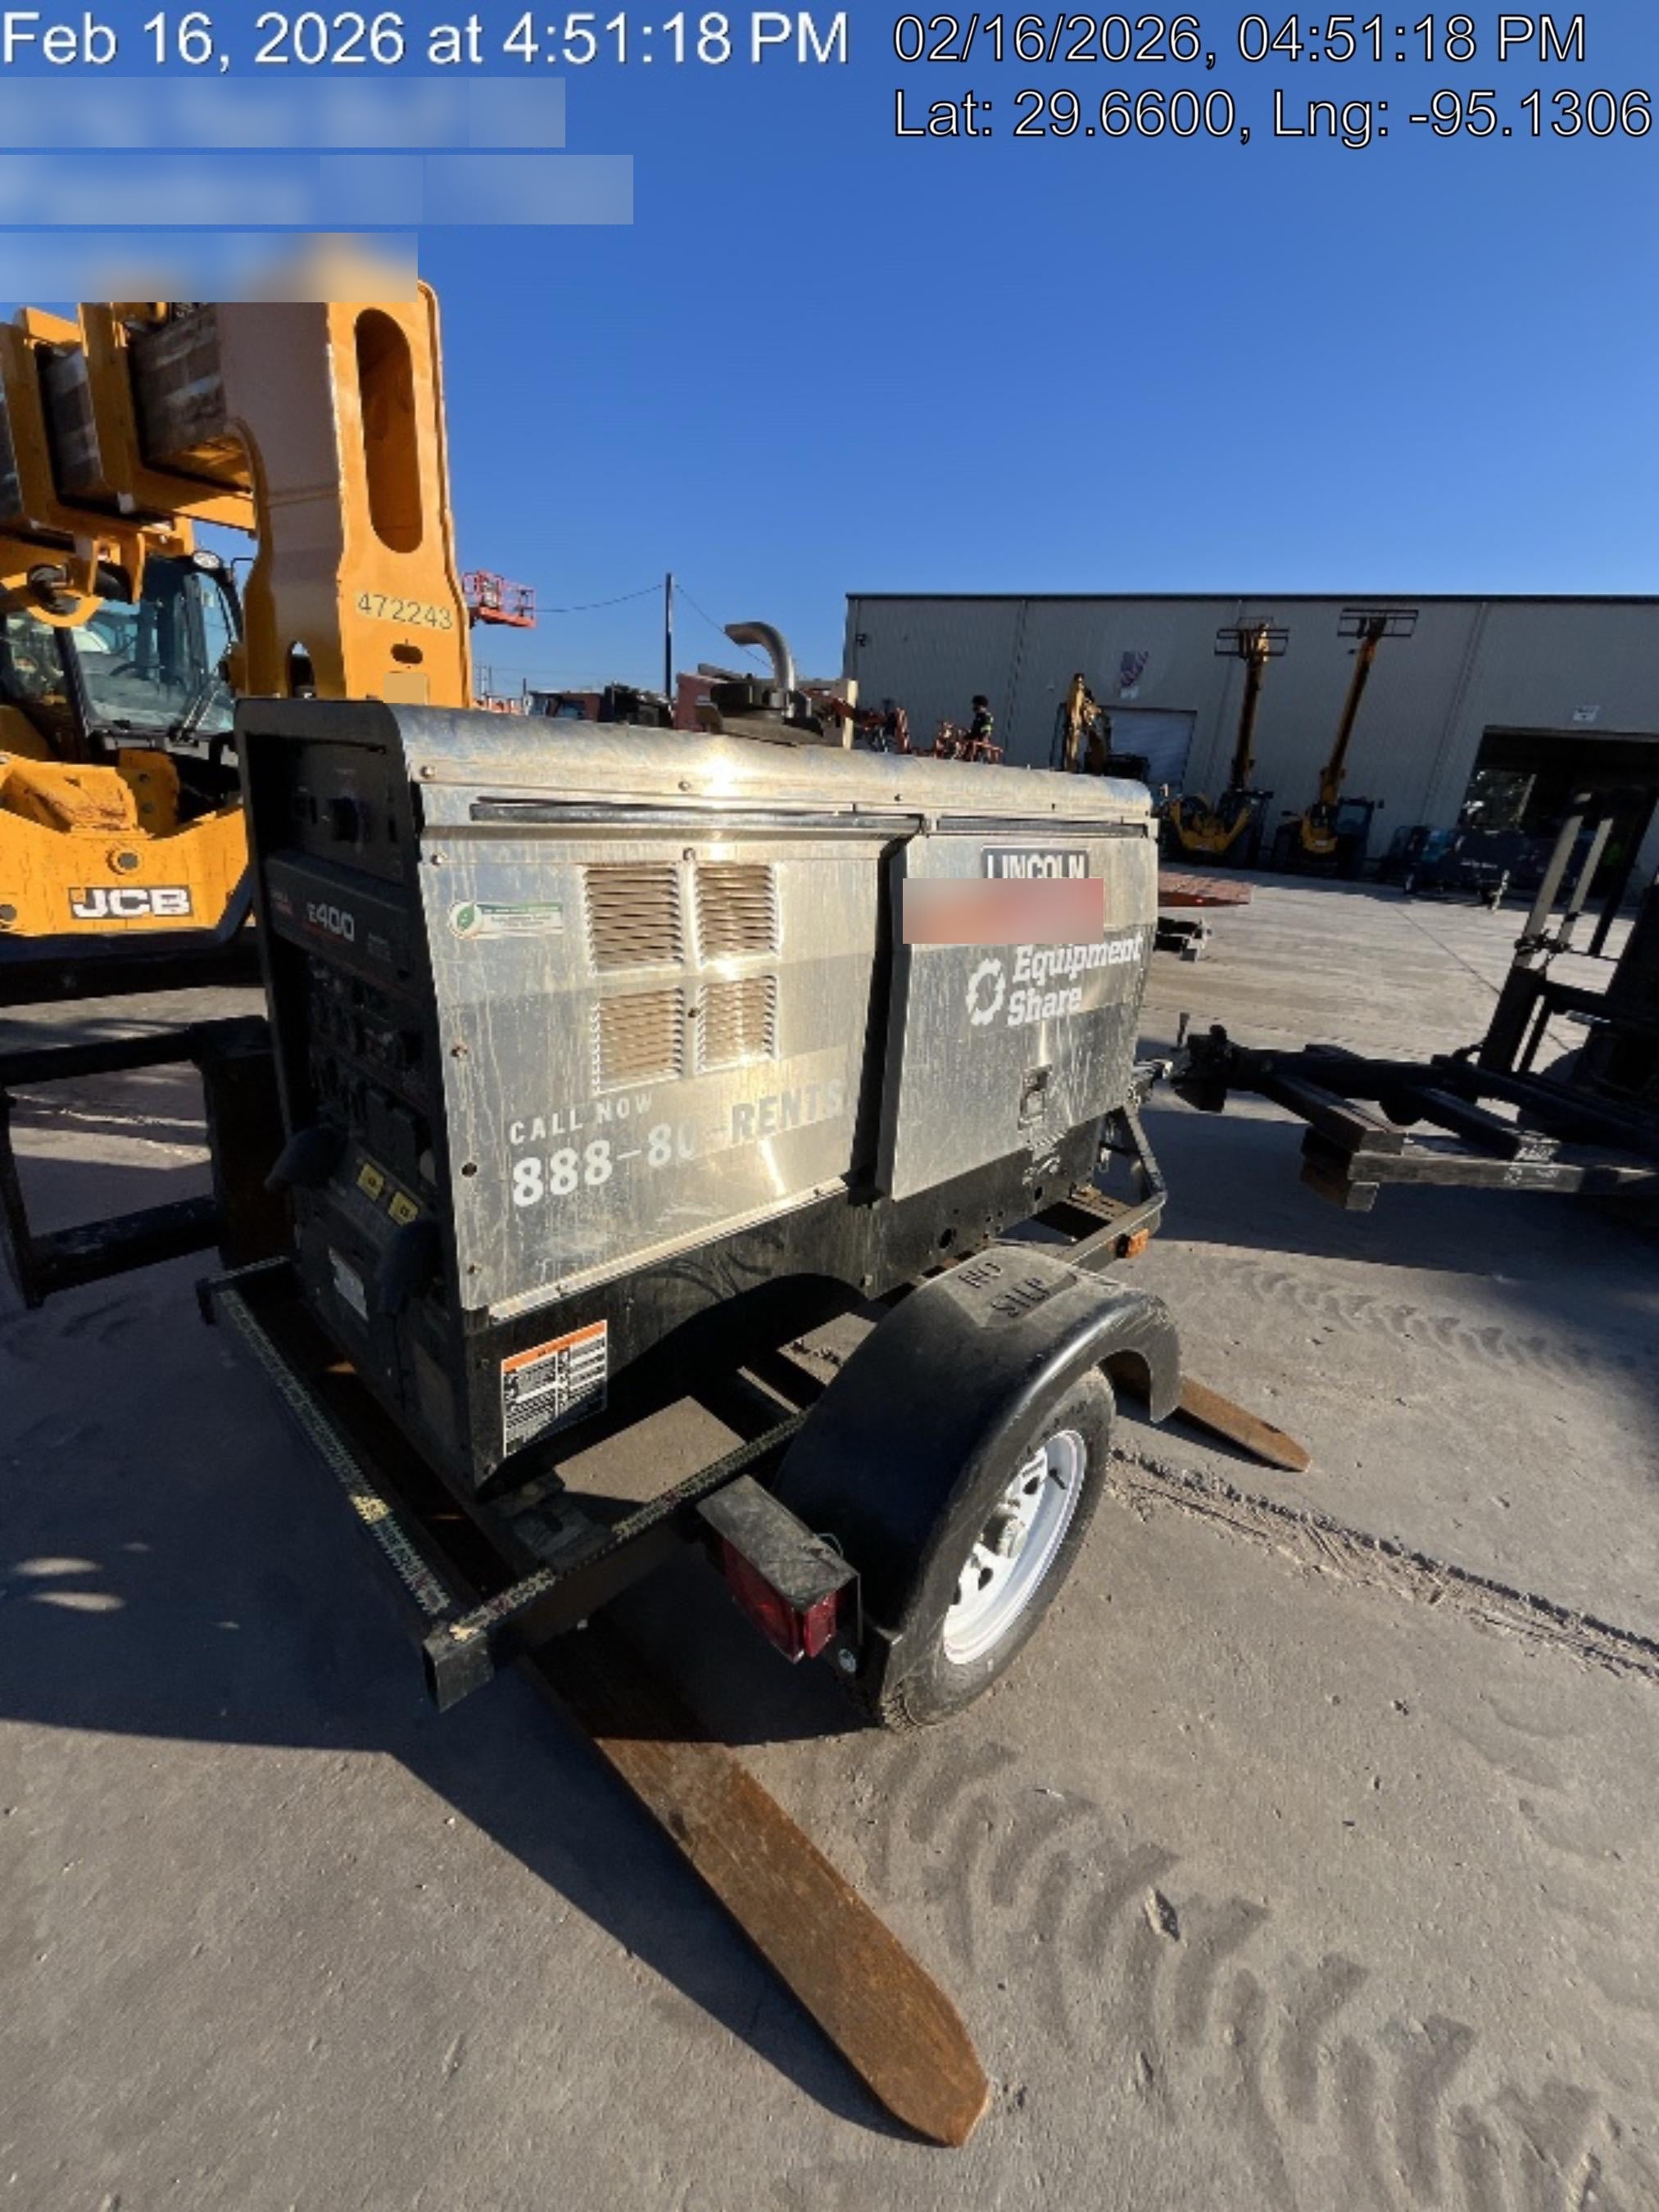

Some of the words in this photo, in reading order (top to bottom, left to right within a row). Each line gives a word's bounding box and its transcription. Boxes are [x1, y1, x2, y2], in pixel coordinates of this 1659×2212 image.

[358, 592, 452, 630] 472243
[987, 854, 1085, 878] LINCOLN
[72, 889, 191, 918] JCB
[1013, 930, 1145, 986] Equipment
[1008, 986, 1082, 1027] Share
[510, 1108, 583, 1145] CALL
[596, 1092, 652, 1125] NOW
[958, 1262, 1002, 1289] NO
